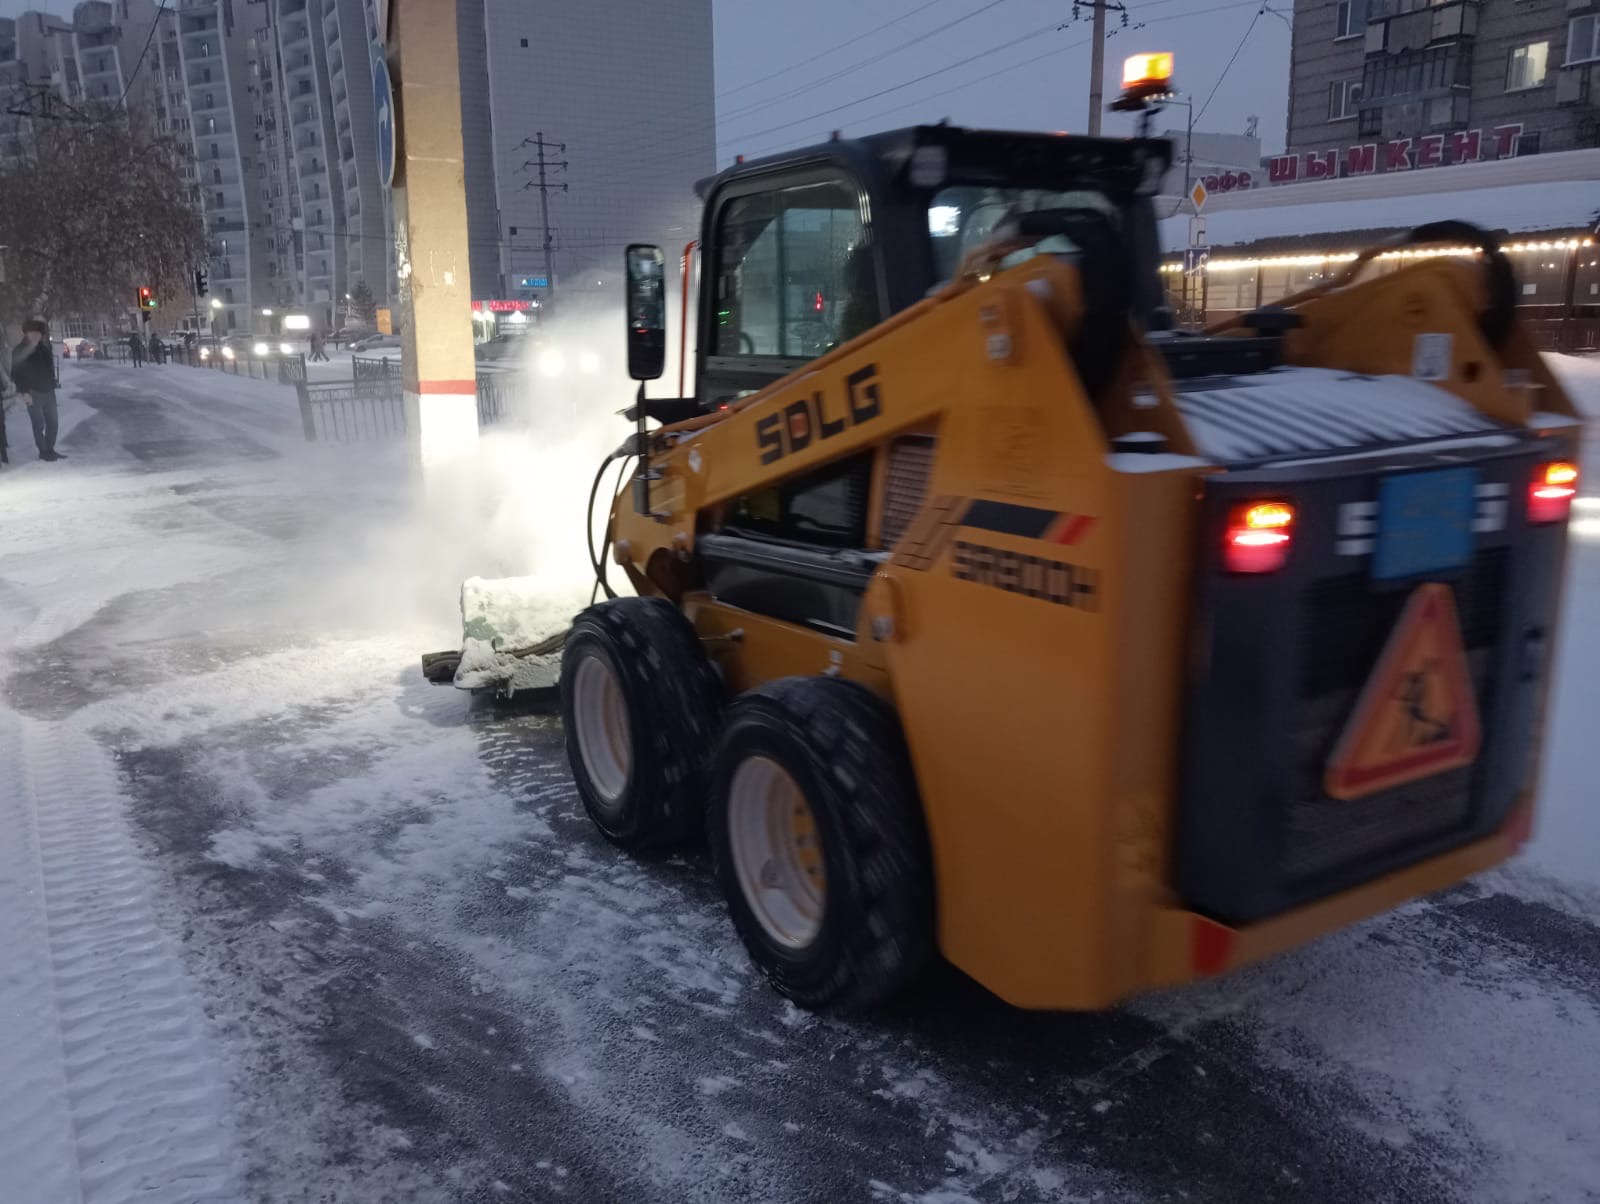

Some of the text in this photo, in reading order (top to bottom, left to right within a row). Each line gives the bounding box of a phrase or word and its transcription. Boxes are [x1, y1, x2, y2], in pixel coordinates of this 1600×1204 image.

[1200, 123, 1523, 193] афе ШЫМКЕНТ
[756, 362, 881, 466] SDLG
